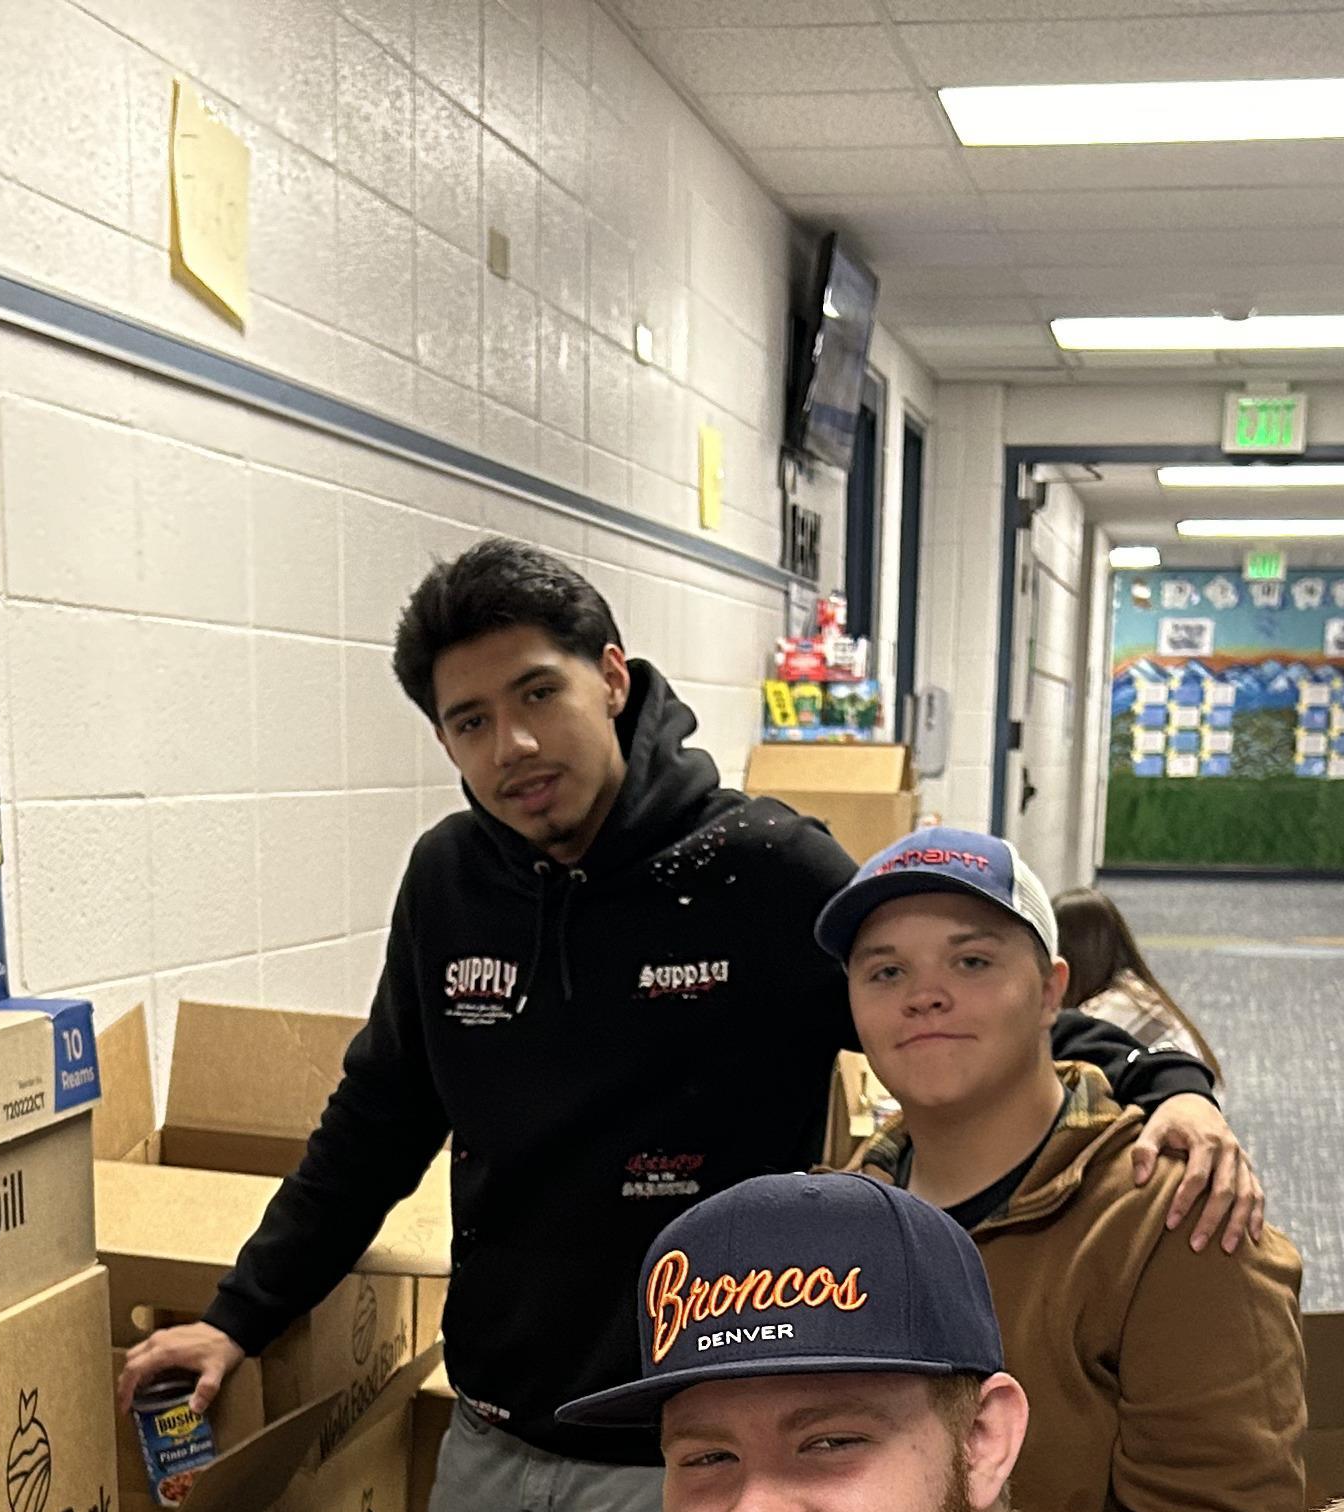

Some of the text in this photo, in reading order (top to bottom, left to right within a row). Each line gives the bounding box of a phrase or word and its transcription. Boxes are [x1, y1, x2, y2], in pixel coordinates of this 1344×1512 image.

[444, 956, 519, 998] SUPPLY
[62, 1028, 83, 1063] 10
[61, 1063, 95, 1092] Reams
[646, 1250, 868, 1365] Broncos
[696, 1323, 794, 1351] DENVER
[160, 1447, 188, 1463] Pinto
